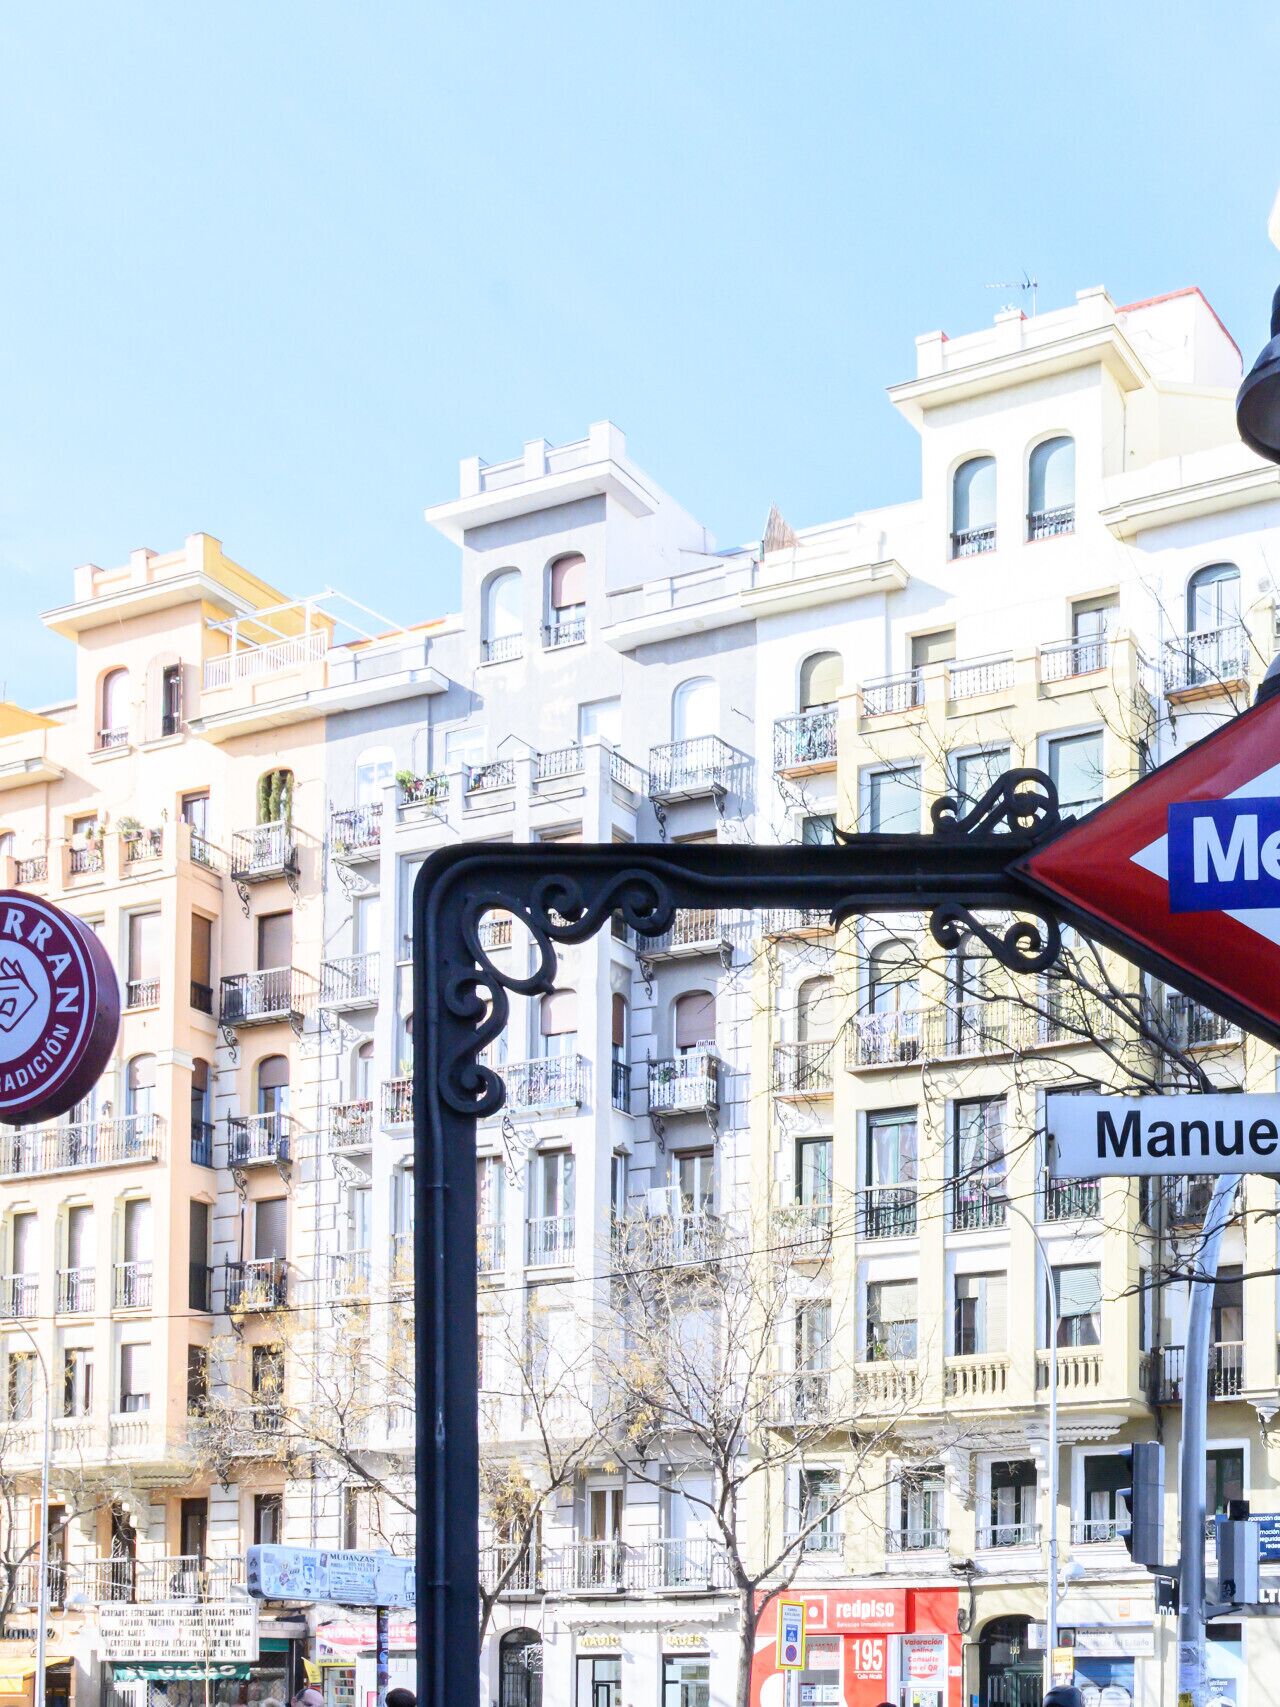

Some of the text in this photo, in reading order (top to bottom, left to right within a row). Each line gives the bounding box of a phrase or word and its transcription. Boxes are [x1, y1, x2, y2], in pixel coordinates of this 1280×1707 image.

[0, 1023, 70, 1093] ADICIÓN
[330, 1553, 375, 1563] MUDANZAS
[836, 1600, 894, 1619] redpiso
[852, 1640, 883, 1670] 195
